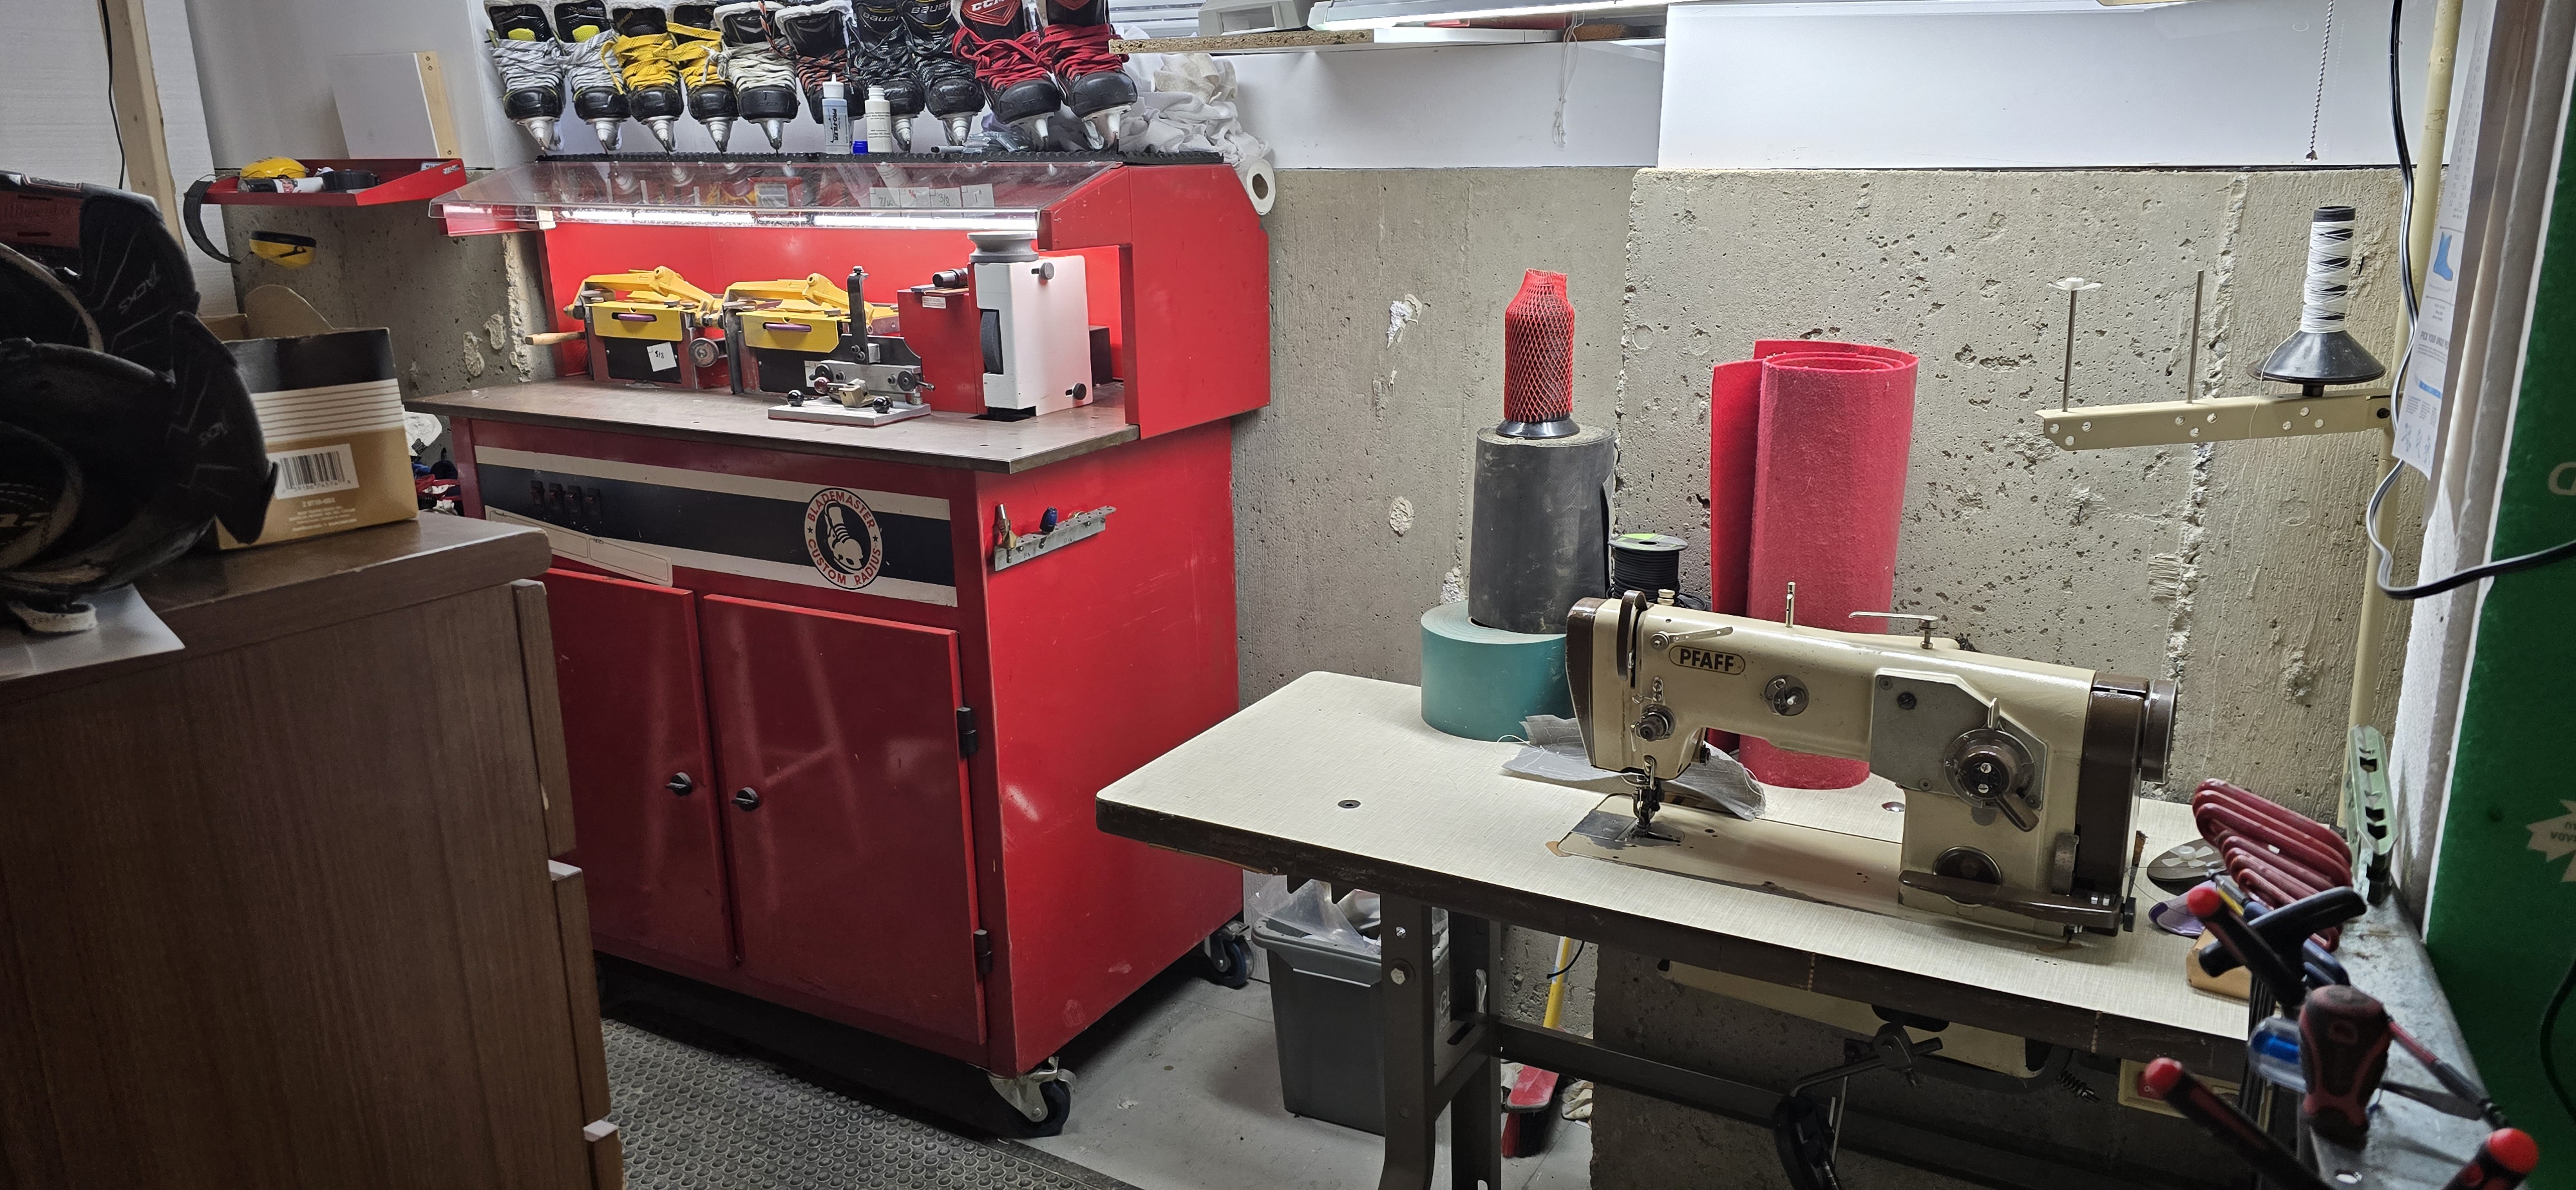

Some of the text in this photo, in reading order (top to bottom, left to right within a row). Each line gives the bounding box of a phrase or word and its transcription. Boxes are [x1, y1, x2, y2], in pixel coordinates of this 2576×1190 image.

[938, 193, 951, 207] 3/8
[807, 491, 875, 529] BLADEMASTER
[808, 538, 881, 585] CUSTOM RADIUS
[1680, 648, 1734, 672] PFAFF
